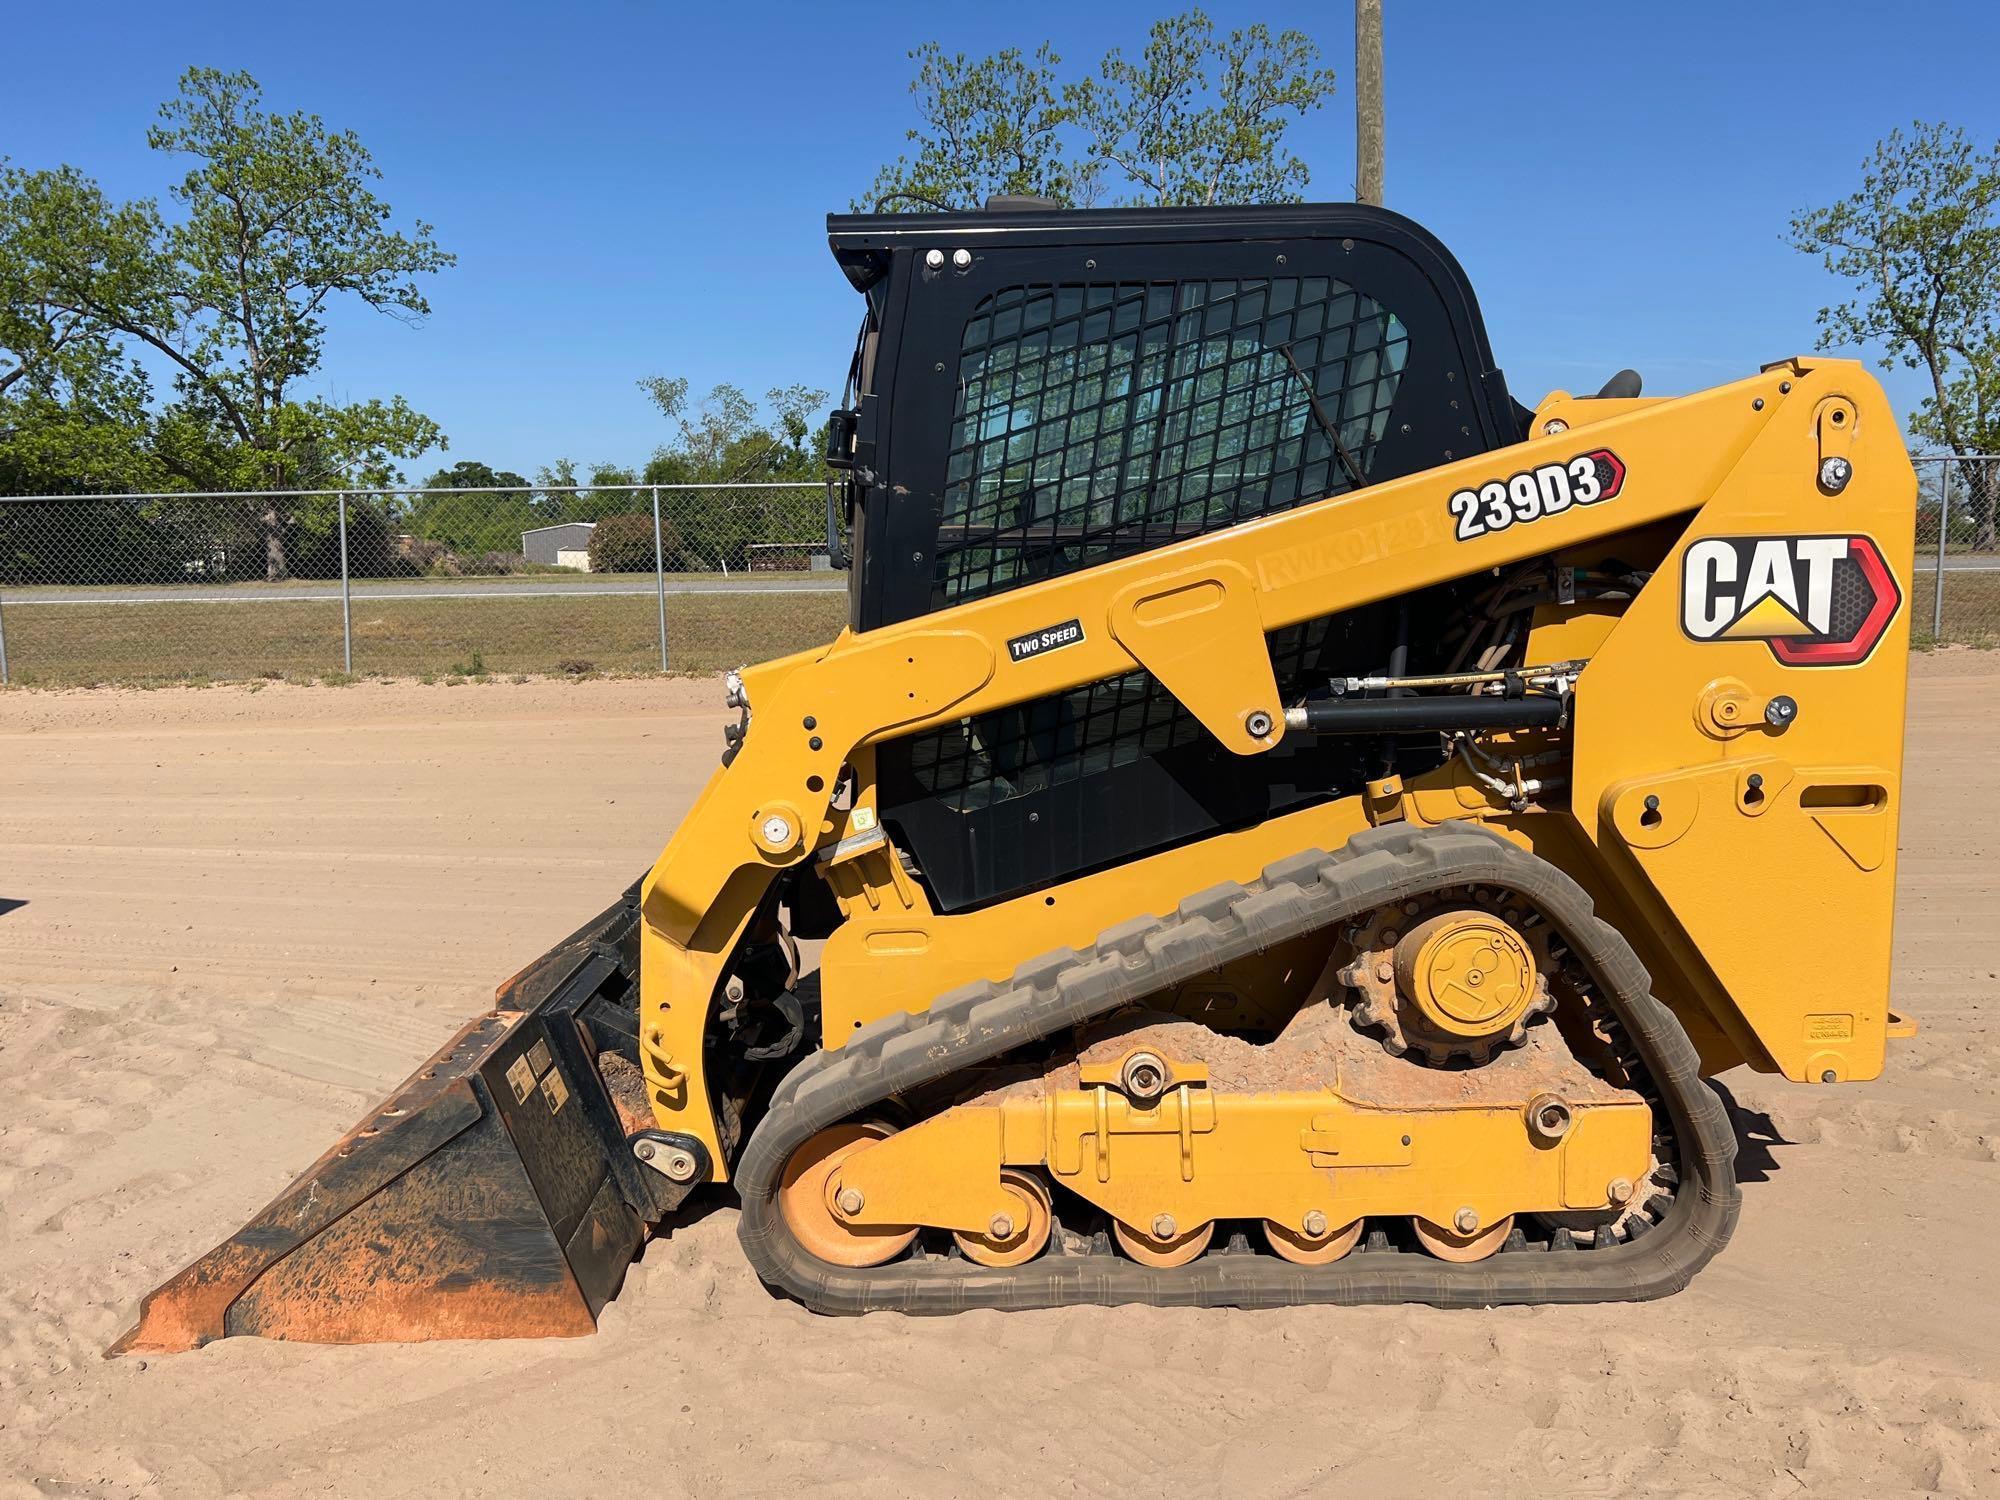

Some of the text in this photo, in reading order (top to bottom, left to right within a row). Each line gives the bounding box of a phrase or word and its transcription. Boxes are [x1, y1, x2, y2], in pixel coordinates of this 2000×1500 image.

[1451, 457, 1601, 539] 239D3
[1684, 538, 1848, 638] CAT
[1013, 626, 1077, 656] TWO SPEED
